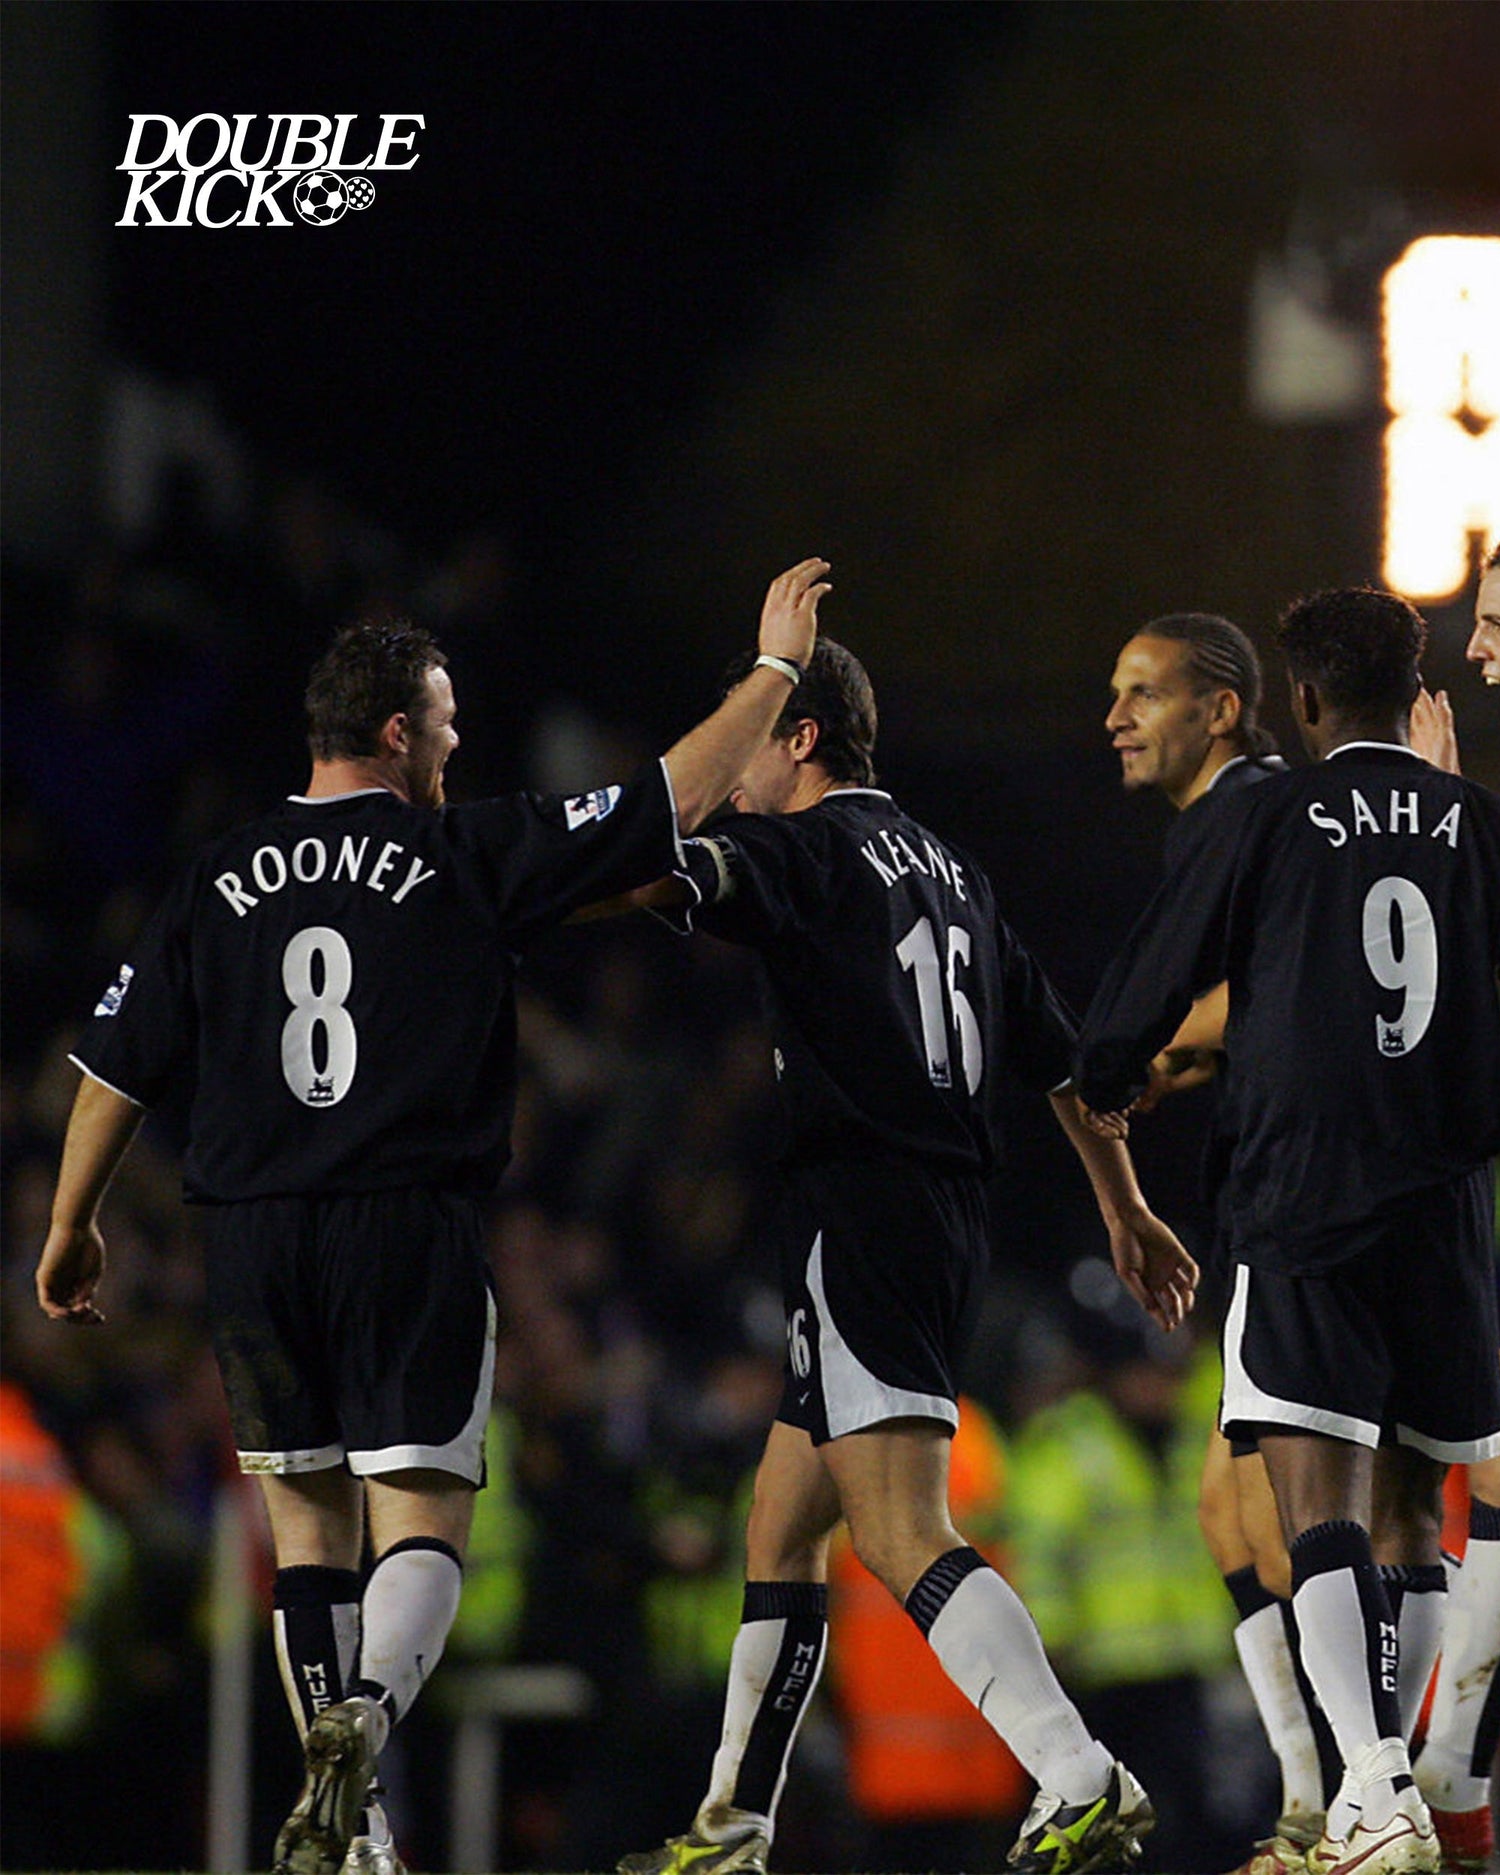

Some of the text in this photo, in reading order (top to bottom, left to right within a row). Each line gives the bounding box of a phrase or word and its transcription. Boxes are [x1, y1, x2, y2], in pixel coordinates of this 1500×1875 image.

[1308, 788, 1462, 848] SAHA
[214, 836, 436, 917] ROONEY
[860, 829, 967, 902] KEANE
[1362, 876, 1438, 1057] 9
[281, 926, 357, 1108] 8
[895, 916, 983, 1096] 16
[787, 1308, 811, 1379] 6
[302, 1663, 331, 1715] MUF
[774, 1642, 816, 1711] MUFC
[1378, 1621, 1398, 1693] MUFC
